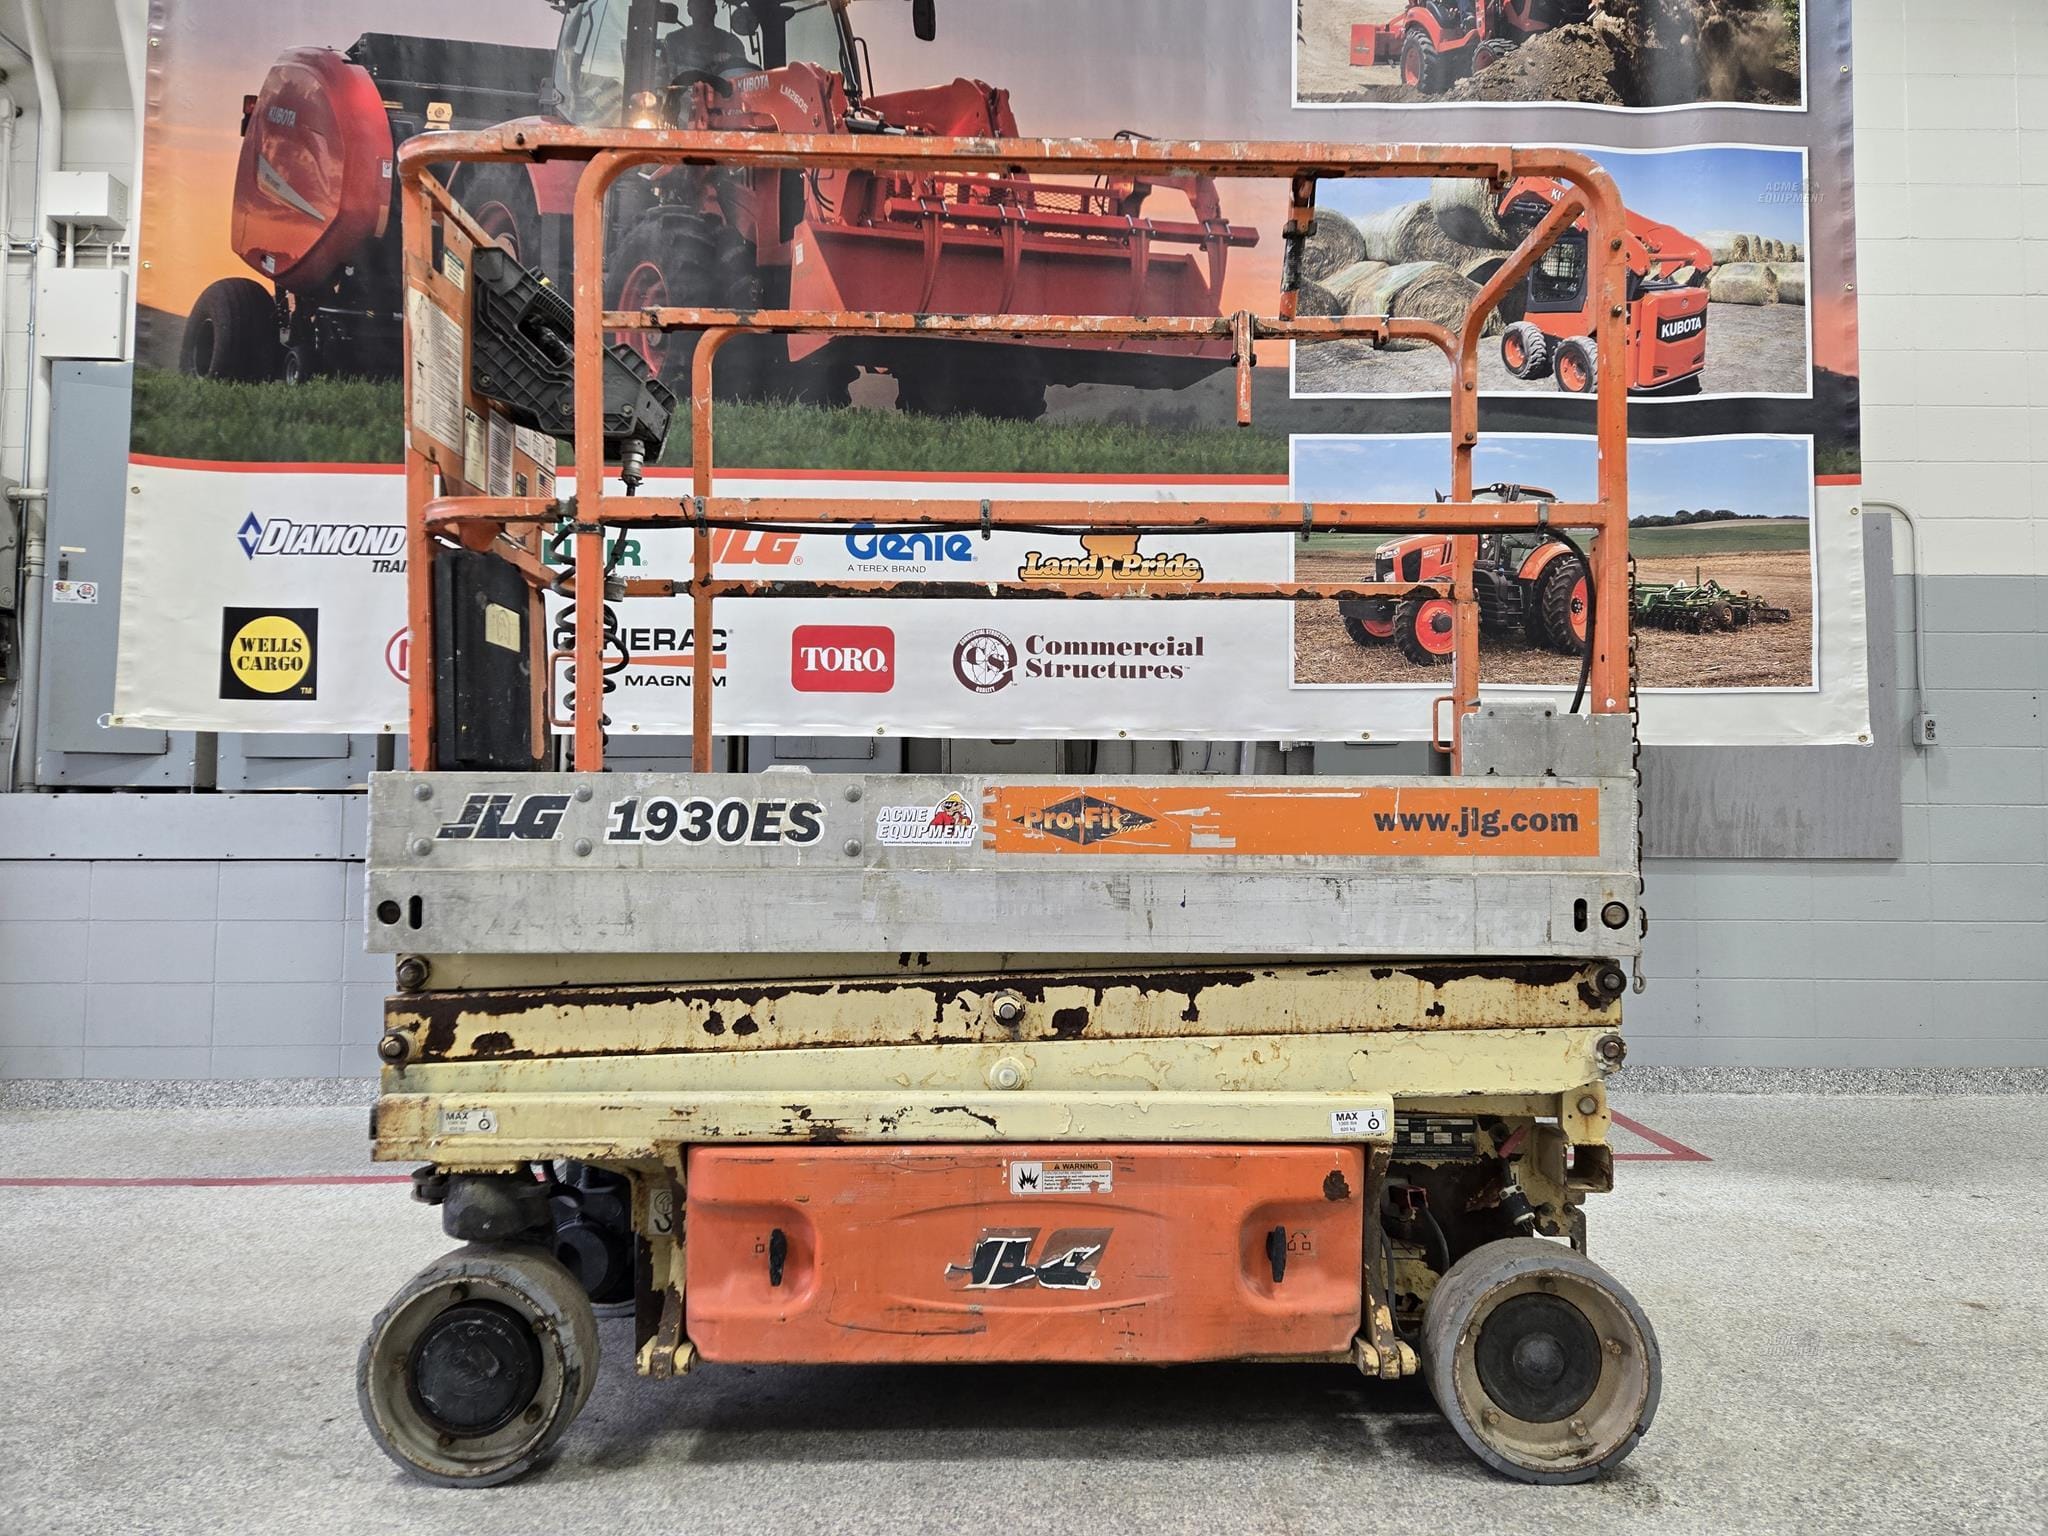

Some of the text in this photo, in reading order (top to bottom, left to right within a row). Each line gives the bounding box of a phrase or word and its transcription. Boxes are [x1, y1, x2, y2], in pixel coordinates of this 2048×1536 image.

[737, 74, 770, 92] KUBOTA
[268, 105, 296, 128] KUBOTA
[1660, 316, 1702, 339] KUBOTA
[255, 518, 407, 556] DIAMOND
[845, 521, 972, 562] Genie
[847, 564, 927, 574] A TEREX BRAND
[1024, 552, 1201, 579] Land Pride
[239, 637, 303, 653] WELLS
[1026, 634, 1204, 656] Commercial
[237, 655, 304, 671] CARGO
[801, 647, 886, 672] TORO
[1025, 658, 1185, 680] Structures
[624, 675, 727, 687] MAGNM
[434, 794, 574, 840] JLG
[606, 798, 825, 844] 1930ES
[879, 807, 928, 823] ACME
[1024, 804, 1122, 830] Pro-Fit
[1373, 806, 1579, 838] www.jlg.com
[878, 824, 977, 840] EQUIPMENT
[445, 1112, 469, 1121] MAX
[1336, 1112, 1359, 1121] MAX
